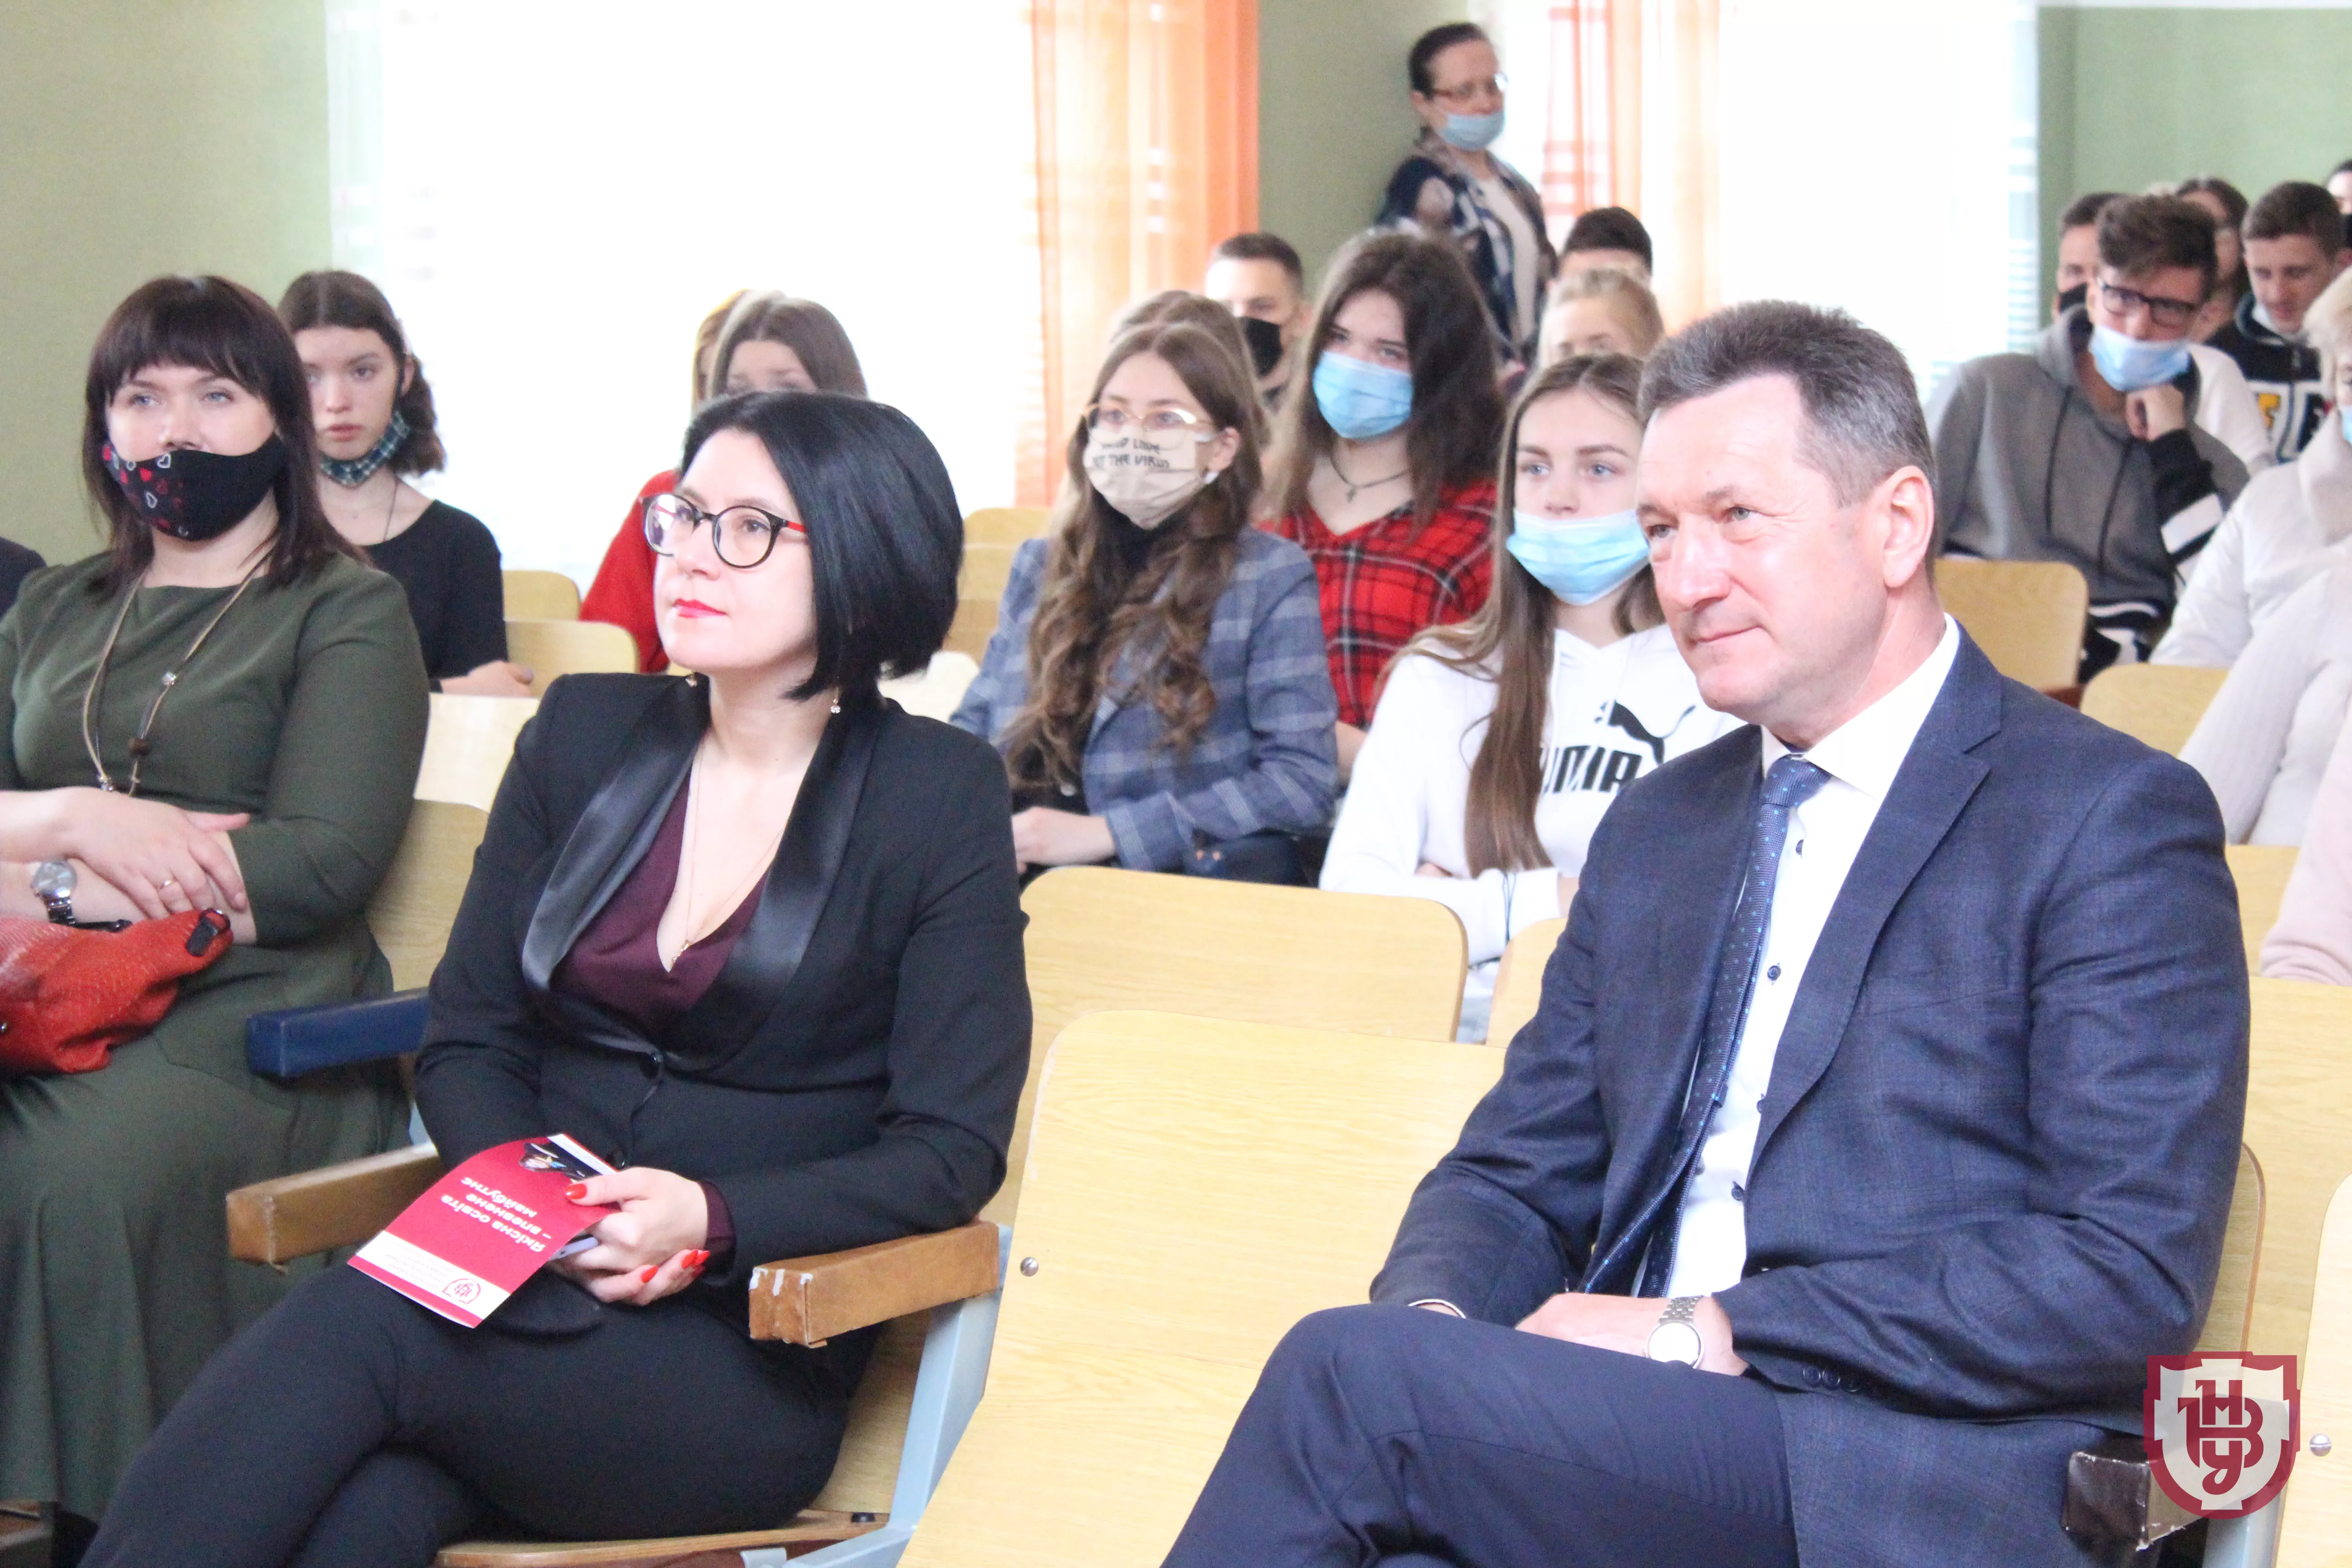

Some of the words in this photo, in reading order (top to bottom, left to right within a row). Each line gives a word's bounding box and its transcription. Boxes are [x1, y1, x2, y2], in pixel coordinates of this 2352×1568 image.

[441, 1195, 491, 1223] освіта
[461, 1177, 537, 1218] майбутнє
[466, 1193, 542, 1235] впевнене
[492, 1220, 546, 1252] Якісна
